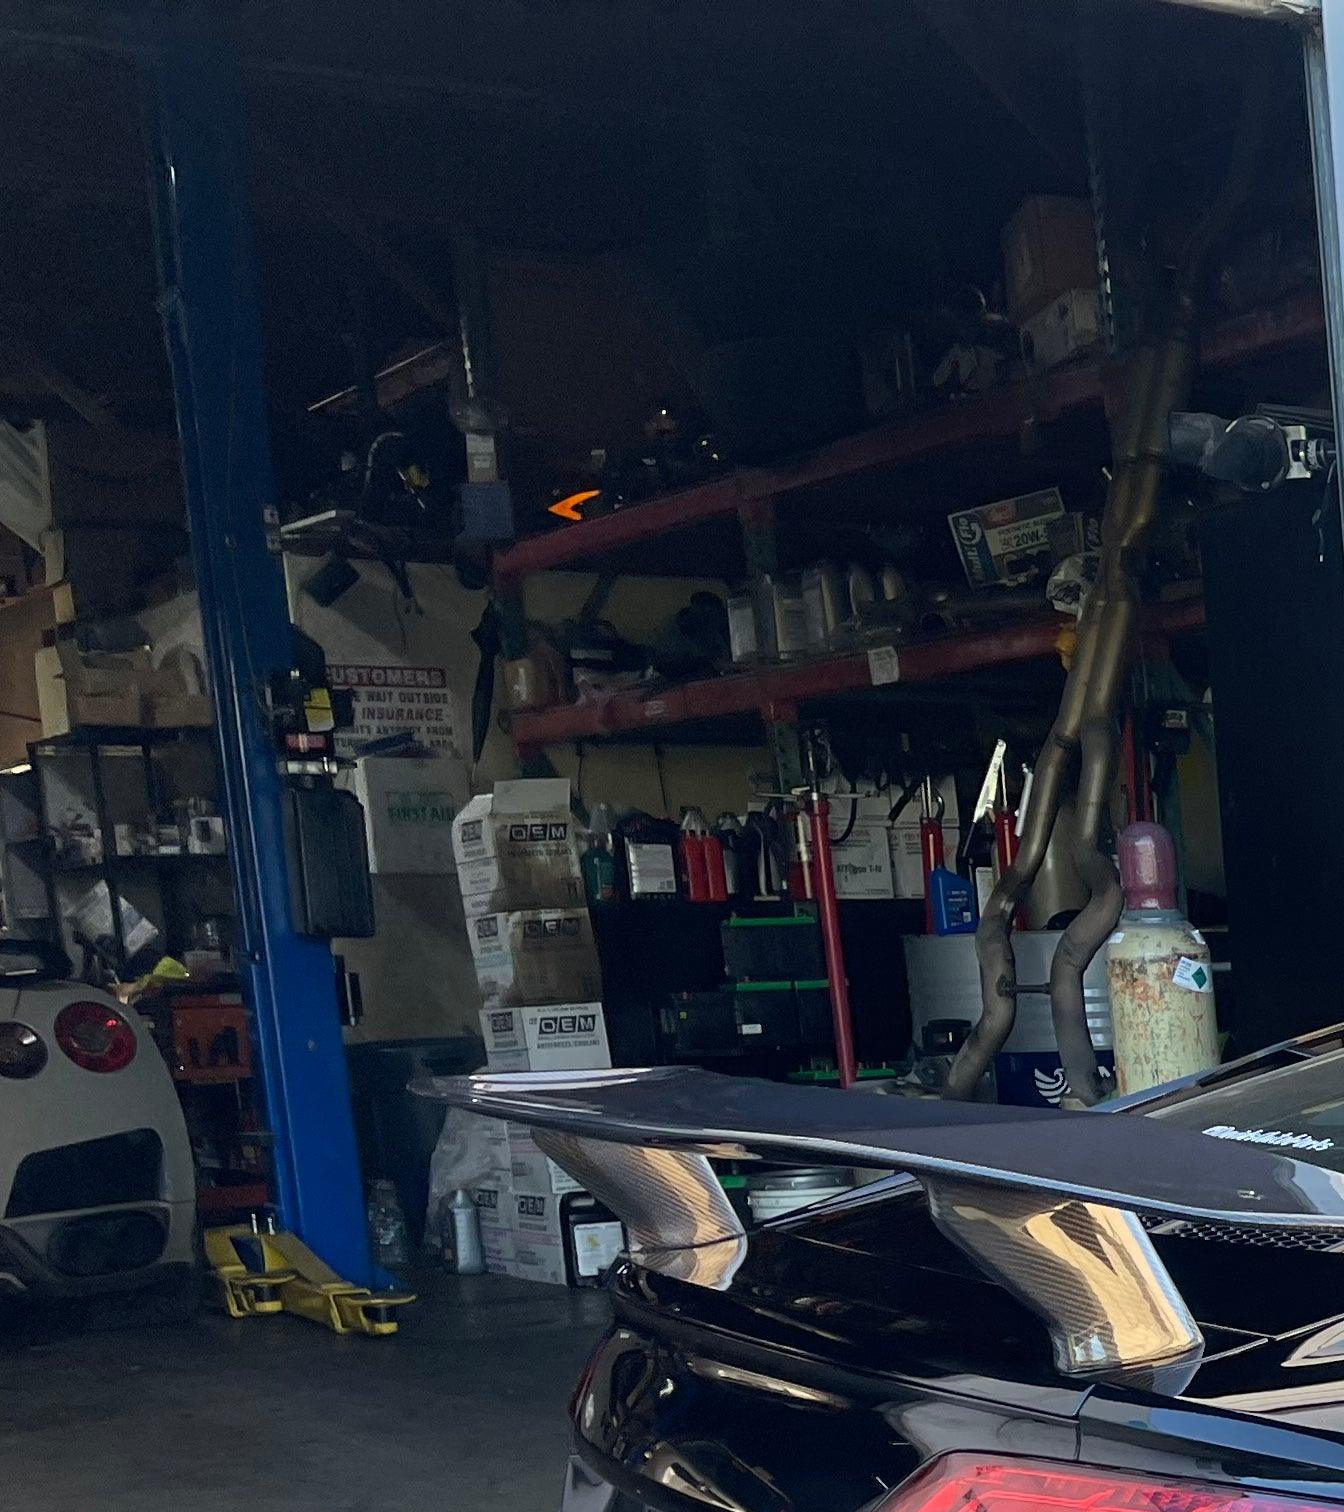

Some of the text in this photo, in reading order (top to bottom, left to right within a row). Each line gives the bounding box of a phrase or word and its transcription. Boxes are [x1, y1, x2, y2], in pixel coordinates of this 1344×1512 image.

[361, 706, 444, 722] INSURANCE
[509, 823, 568, 842] OEM
[539, 1015, 597, 1035] OEM
